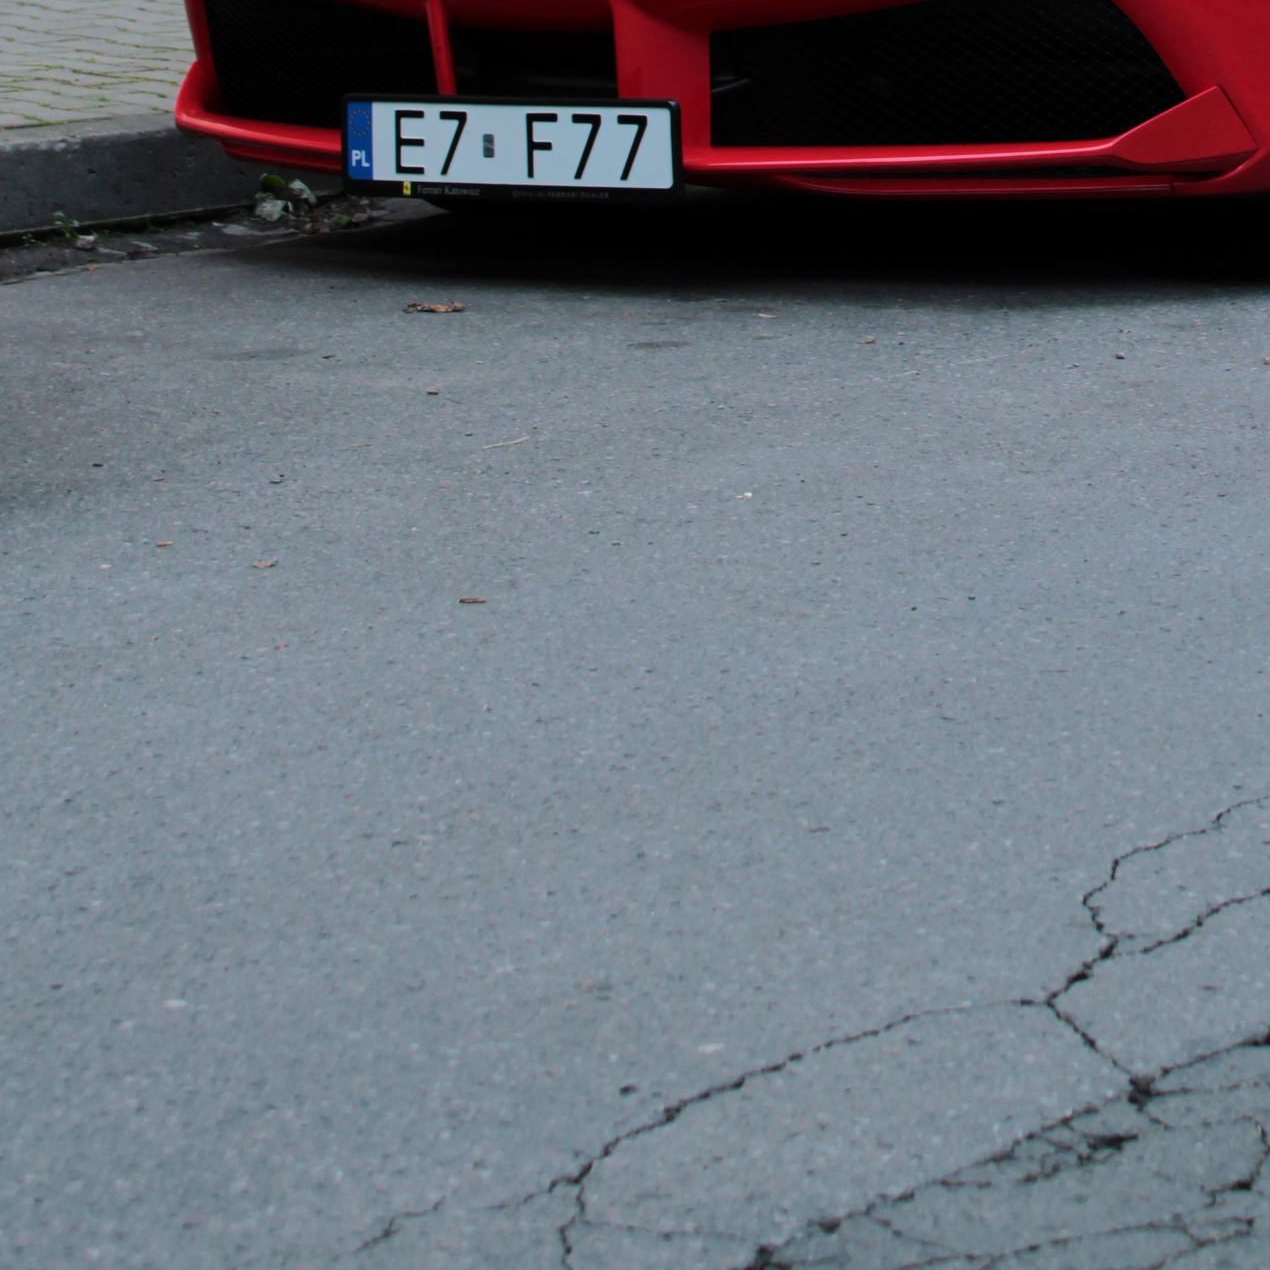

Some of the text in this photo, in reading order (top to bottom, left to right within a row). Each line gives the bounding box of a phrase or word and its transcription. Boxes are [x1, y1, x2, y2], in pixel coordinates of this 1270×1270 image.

[351, 149, 371, 168] PL
[395, 110, 648, 181] E7 F77
